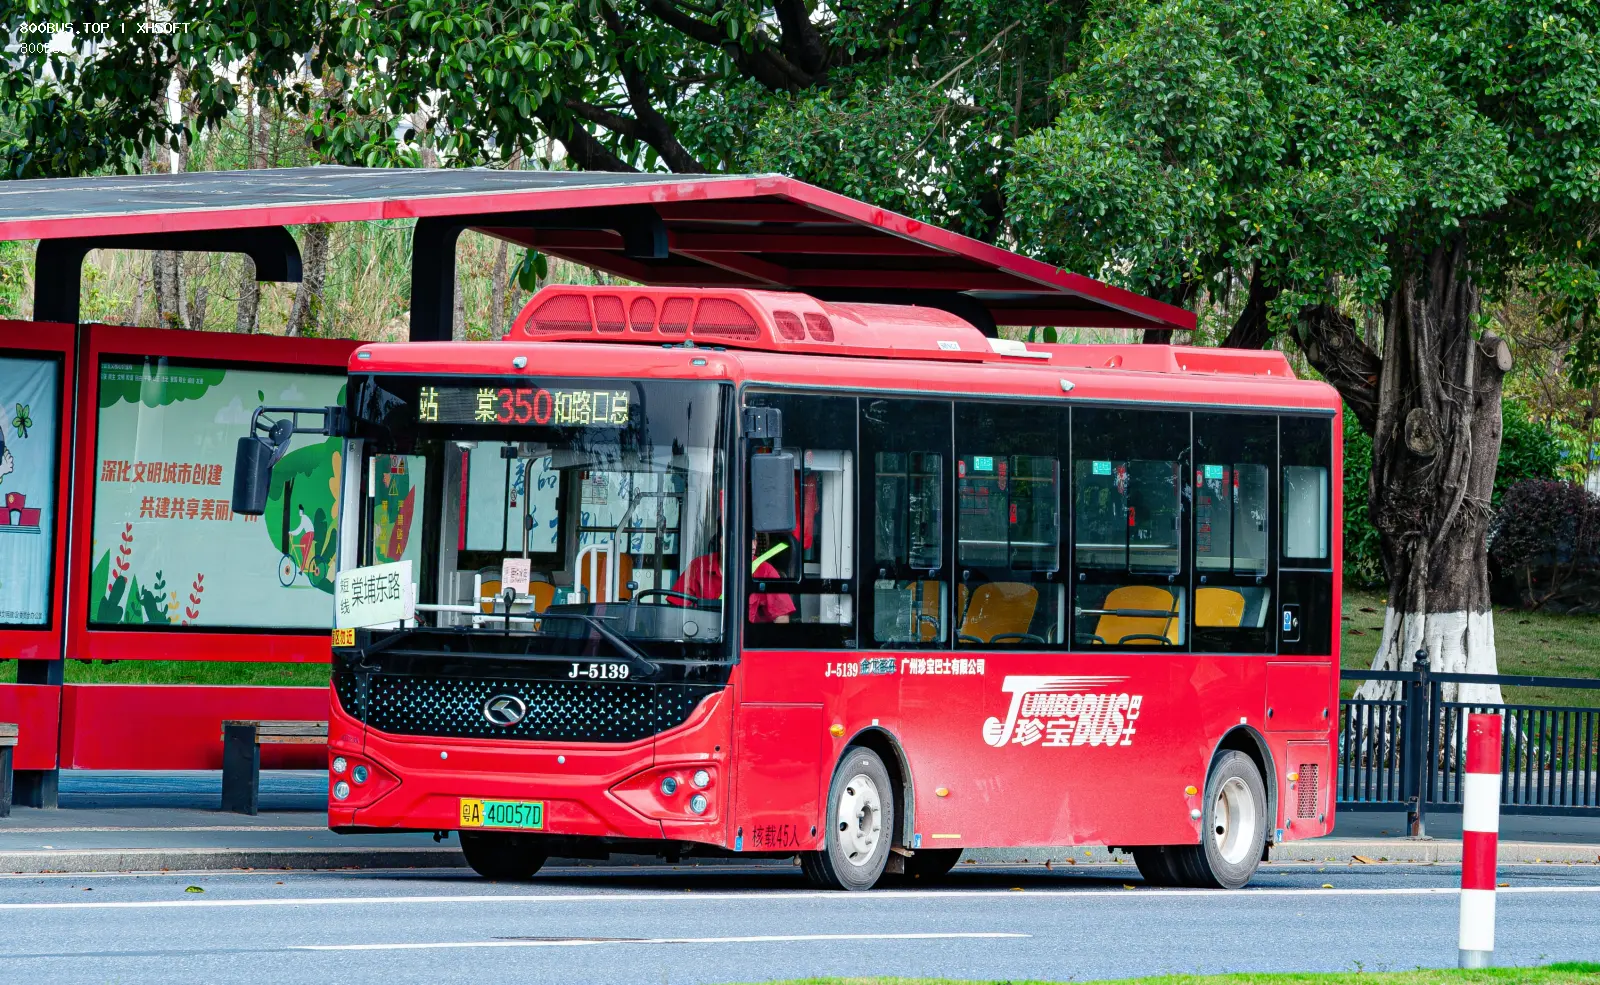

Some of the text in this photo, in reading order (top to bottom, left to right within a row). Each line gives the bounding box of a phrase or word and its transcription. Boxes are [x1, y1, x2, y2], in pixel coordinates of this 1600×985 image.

[420, 387, 629, 424] 站 棠 350 和路口总
[100, 459, 223, 486] 深化文明城市创建
[139, 495, 258, 522] 共建共享美丽
[340, 577, 351, 615] 短线
[351, 571, 401, 607] 棠埔东路
[568, 663, 629, 679] J-5139
[825, 663, 858, 677] J-5139
[901, 658, 985, 675] 广州珍宝巴士有限公司
[1011, 695, 1143, 747] 珍宝 巴士
[463, 803, 541, 825] 粤A 40057D
[752, 825, 800, 848] 核载45人
